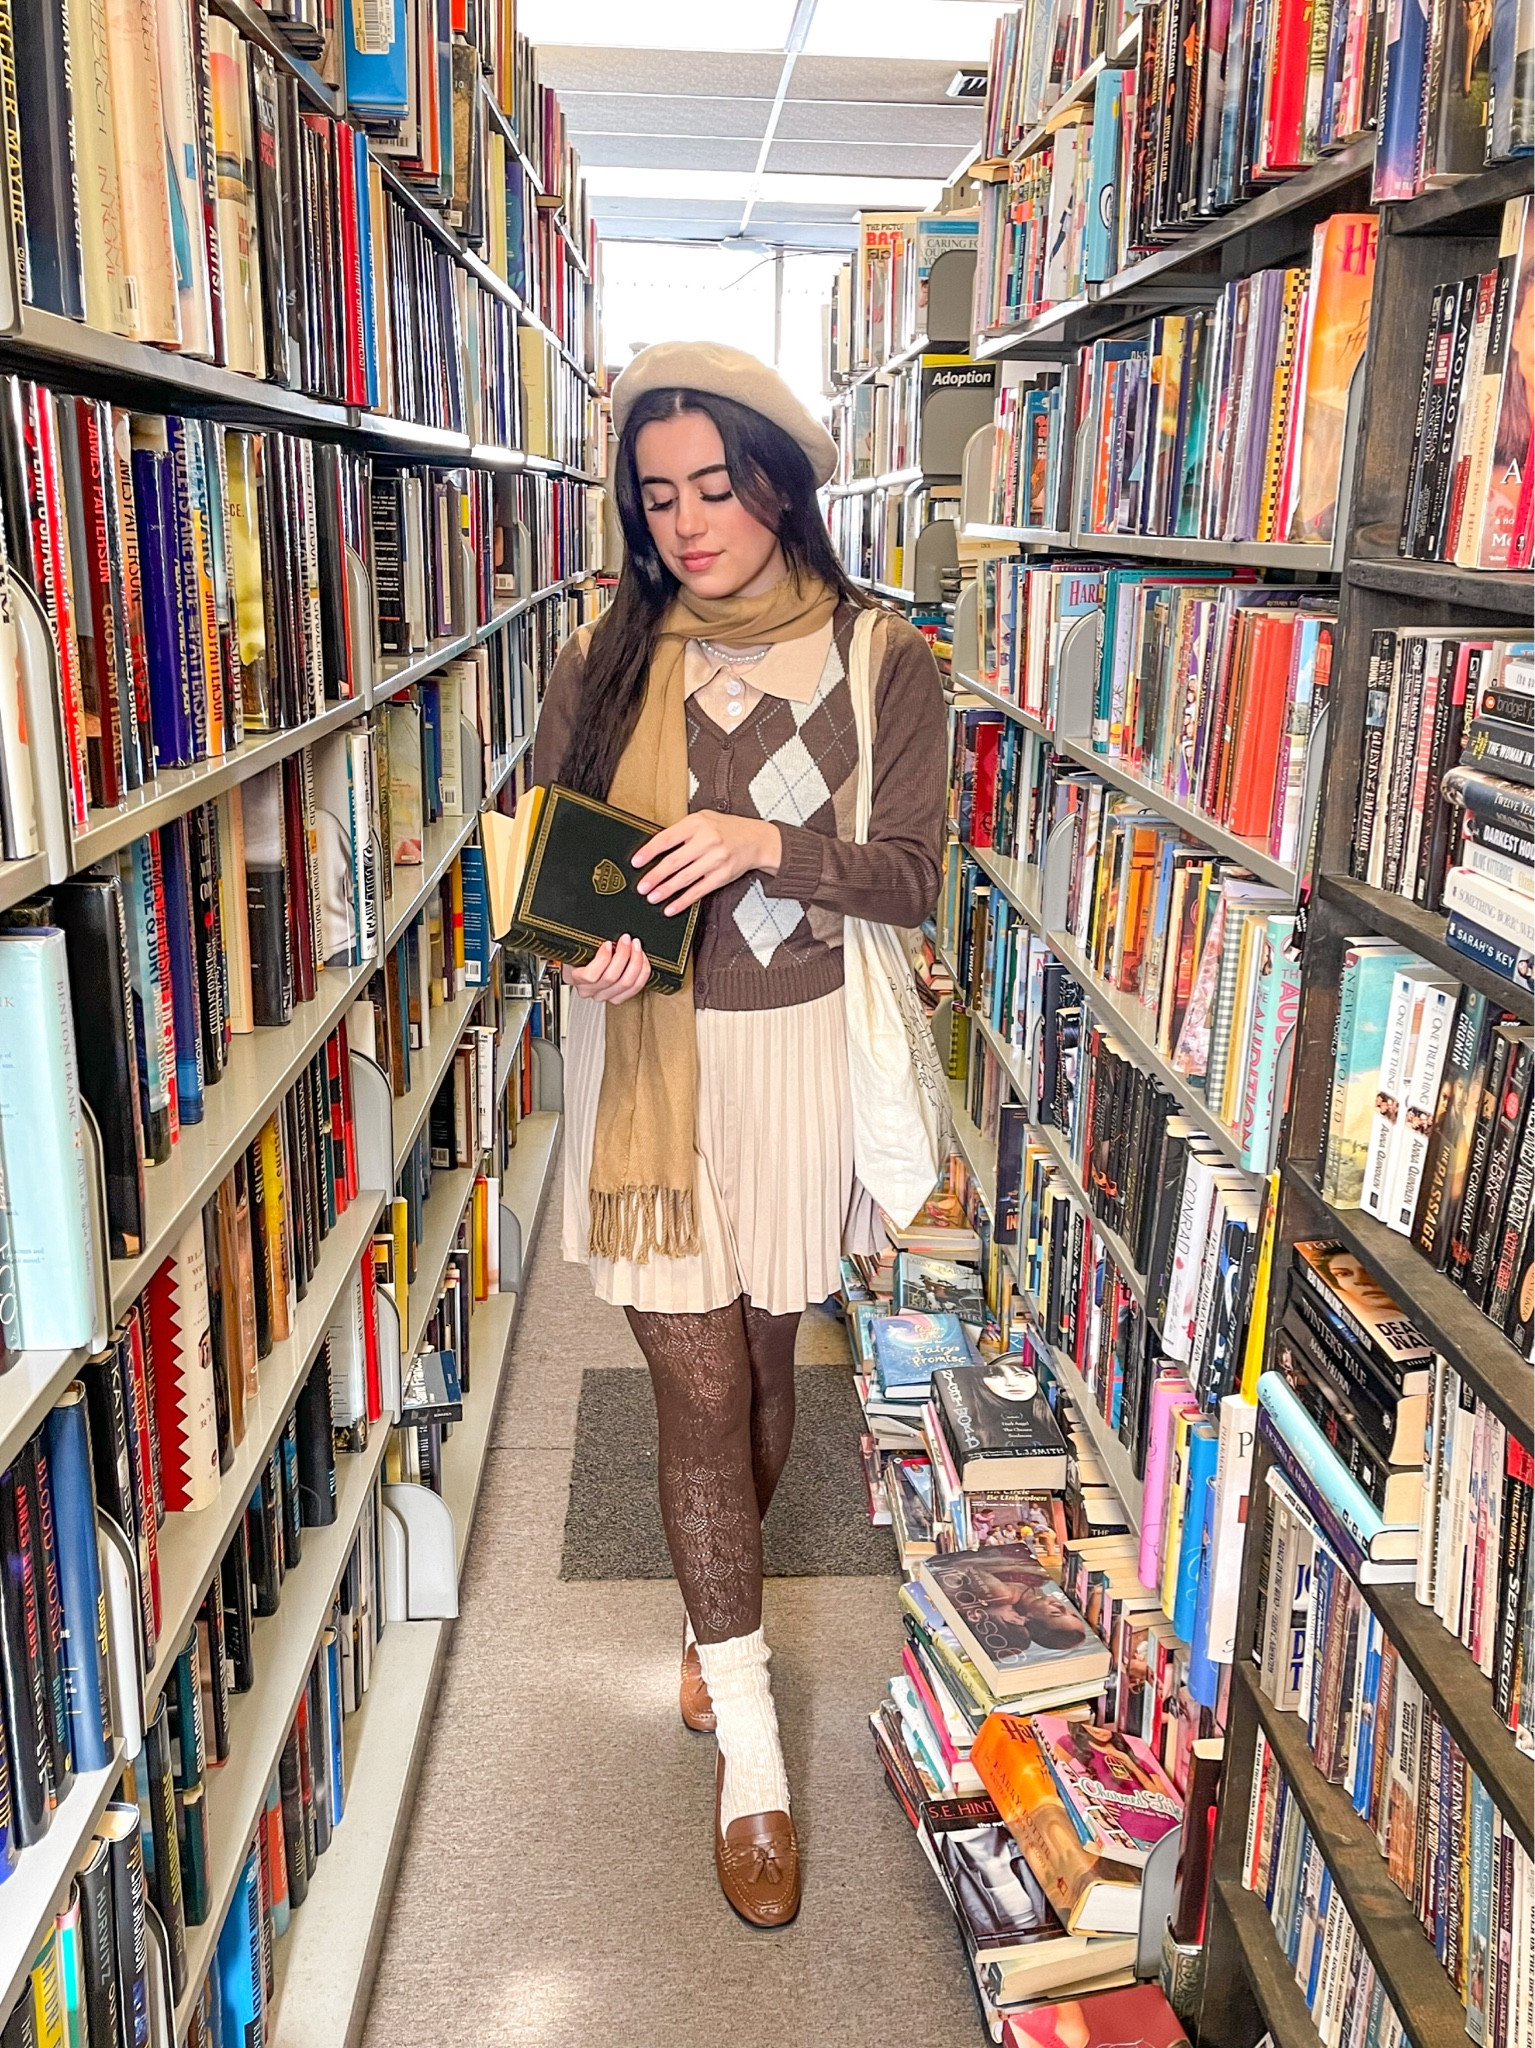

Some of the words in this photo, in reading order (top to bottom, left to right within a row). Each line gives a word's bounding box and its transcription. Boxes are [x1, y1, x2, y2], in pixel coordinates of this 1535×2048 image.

[209, 226, 224, 299] ARTIST
[927, 237, 967, 249] CARING
[1492, 277, 1511, 355] Simpson
[1426, 328, 1437, 357] THE
[932, 370, 992, 388] Adoption
[1447, 323, 1470, 425] APOLLO
[1413, 359, 1433, 438] ACCUSED
[87, 416, 101, 478] JAMES
[1428, 395, 1444, 463] AMERICAN
[1440, 429, 1453, 454] 13
[1476, 391, 1494, 477] ANYWHERE
[174, 428, 194, 514] VIOLETS
[1470, 483, 1481, 507] BUT
[92, 486, 111, 584] PATTERSON
[124, 498, 144, 604] PATTERSON
[180, 517, 196, 557] ARE
[1464, 512, 1478, 552] HERE
[182, 563, 200, 610] BLUE
[102, 604, 118, 667] CROSS
[107, 672, 119, 699] MY
[189, 632, 208, 744] PATTERSON
[1368, 655, 1382, 689] BROOKS
[1412, 674, 1423, 696] THE
[1426, 675, 1439, 711] THE
[1496, 696, 1526, 719] bridget
[1409, 699, 1421, 729] HAND
[1431, 677, 1449, 768] KATZENBACH
[1440, 704, 1450, 743] JOHN
[109, 705, 123, 766] HEART
[1367, 730, 1384, 779] GUESTS
[1406, 729, 1418, 758] THAT
[1418, 715, 1435, 765] HARD
[1488, 741, 1500, 757] THE
[1499, 745, 1525, 765] WOMAN
[1523, 752, 1532, 767] IN
[1401, 758, 1414, 794] ROCKS
[1412, 768, 1429, 814] WAY
[1275, 794, 1288, 828] Cupid
[1359, 791, 1377, 852] EMPEROR
[1398, 796, 1408, 817] THE
[1493, 793, 1520, 812] TWELVE
[1393, 818, 1406, 860] CRADLE
[1483, 825, 1519, 854] DARKEST
[140, 844, 157, 916] JUDGE
[1472, 851, 1487, 873] OLIVE
[1486, 857, 1514, 884] KITTERIDGE
[1459, 888, 1497, 920] SOMETHING
[147, 933, 161, 986] JURY
[1456, 927, 1495, 957] SARAH'S
[1494, 950, 1516, 969] KEY
[204, 958, 218, 1002] LINCOLN
[57, 980, 72, 1057] BENTON
[153, 987, 165, 1018] JAMES
[162, 999, 175, 1029] THE
[208, 1002, 221, 1035] CHILD
[1344, 971, 1358, 1030] NEWS
[1396, 1004, 1407, 1023] ONE
[1330, 1014, 1343, 1057] WORLD
[1391, 1025, 1405, 1057] TRUE
[1429, 1017, 1441, 1042] ONE
[1452, 1012, 1470, 1066] CRONIN
[1461, 1020, 1477, 1071] JUSTIN
[156, 1018, 172, 1103] PATTERSON
[1386, 1056, 1401, 1090] THING
[1426, 1043, 1439, 1071] TRUE
[64, 1061, 78, 1122] FRANK
[1332, 1051, 1349, 1125] WORLD
[1418, 1071, 1434, 1107] THING
[1378, 1123, 1391, 1149] ANNA
[1411, 1138, 1424, 1165] ANNA
[1440, 1144, 1452, 1164] THE
[1470, 1130, 1488, 1171] JOHN
[1500, 1136, 1512, 1165] THE
[1372, 1149, 1388, 1190] QUINDLEN
[1403, 1165, 1421, 1206] QUINDLEN
[1484, 1149, 1501, 1198] STORM
[1420, 1162, 1447, 1253] PASSAGE
[1459, 1171, 1481, 1235] GRISHAM
[1486, 1167, 1507, 1224] PERFECT
[1506, 1164, 1532, 1233] INNOCENT
[1176, 1175, 1198, 1256] CONRAD
[1474, 1230, 1492, 1286] SEBASTIAN
[1199, 1282, 1213, 1328] DARKEST
[912, 1354, 967, 1366] Promise
[1302, 1297, 1344, 1360] WINTER'S
[1344, 1348, 1368, 1385] TALE
[1310, 1338, 1329, 1369] MARK
[15, 1484, 31, 1549] JAMES
[1000, 1494, 1048, 1502] Unbroken
[145, 1499, 158, 1562] CHINA
[1508, 1481, 1523, 1568] HILLENBRAND
[1518, 1511, 1529, 1551] LAURA
[36, 1455, 55, 1551] BLOOD
[46, 1558, 63, 1654] MONEY
[1275, 1565, 1285, 1574] ON
[1276, 1538, 1287, 1564] DANCE
[1273, 1589, 1284, 1608] WIND
[1274, 1574, 1284, 1588] THE
[22, 1550, 39, 1660] GRIPPANDO
[1499, 1573, 1521, 1713] SEABISCUIT
[1401, 1701, 1412, 1732] LOUIS
[1431, 1720, 1443, 1751] JASON
[1399, 1732, 1411, 1775] L'AMOUR
[1430, 1751, 1442, 1782] EVERS:
[161, 1770, 175, 1824] JOHN
[1078, 1777, 1144, 1808] Charmed
[1430, 1782, 1442, 1801] HIS
[1442, 1758, 1451, 1798] FLYNN
[928, 1803, 954, 1819] S.E.
[1428, 1800, 1441, 1825] OWN
[1450, 1781, 1464, 1825] FLYNN
[1427, 1824, 1440, 1854] STORY
[1439, 1801, 1450, 1858] HELL'S
[1451, 1826, 1463, 1856] LAST
[1474, 1802, 1484, 1848] THUNDER
[293, 1840, 306, 1877] SMITH
[1473, 1849, 1482, 1876] OVER
[1482, 1821, 1492, 1871] CHARLES
[1493, 1836, 1501, 1856] THE
[1450, 1855, 1462, 1892] WALTZ
[1481, 1872, 1491, 1886] G.
[1492, 1860, 1501, 1888] HIGH
[1504, 1849, 1514, 1884] SILVER
[131, 1869, 144, 1907] LISA
[1449, 1892, 1459, 1910] ON
[1480, 1889, 1490, 1918] WEST
[1502, 1884, 1513, 1930] CANYON
[1326, 1915, 1339, 1952] HORSE
[1448, 1908, 1461, 1942] WILD
[1490, 1891, 1500, 1947] GRADERS
[96, 1885, 112, 1986] HURWITZ
[107, 1981, 118, 2026] OUT
[133, 1906, 147, 1975] JACKSON
[1331, 1956, 1339, 1982] LOUIS
[1448, 1942, 1460, 1979] HORSE
[1489, 1949, 1498, 1982] LOUIS
[1500, 1963, 1510, 1995] LOUIS
[40, 1952, 65, 2038] NATURE
